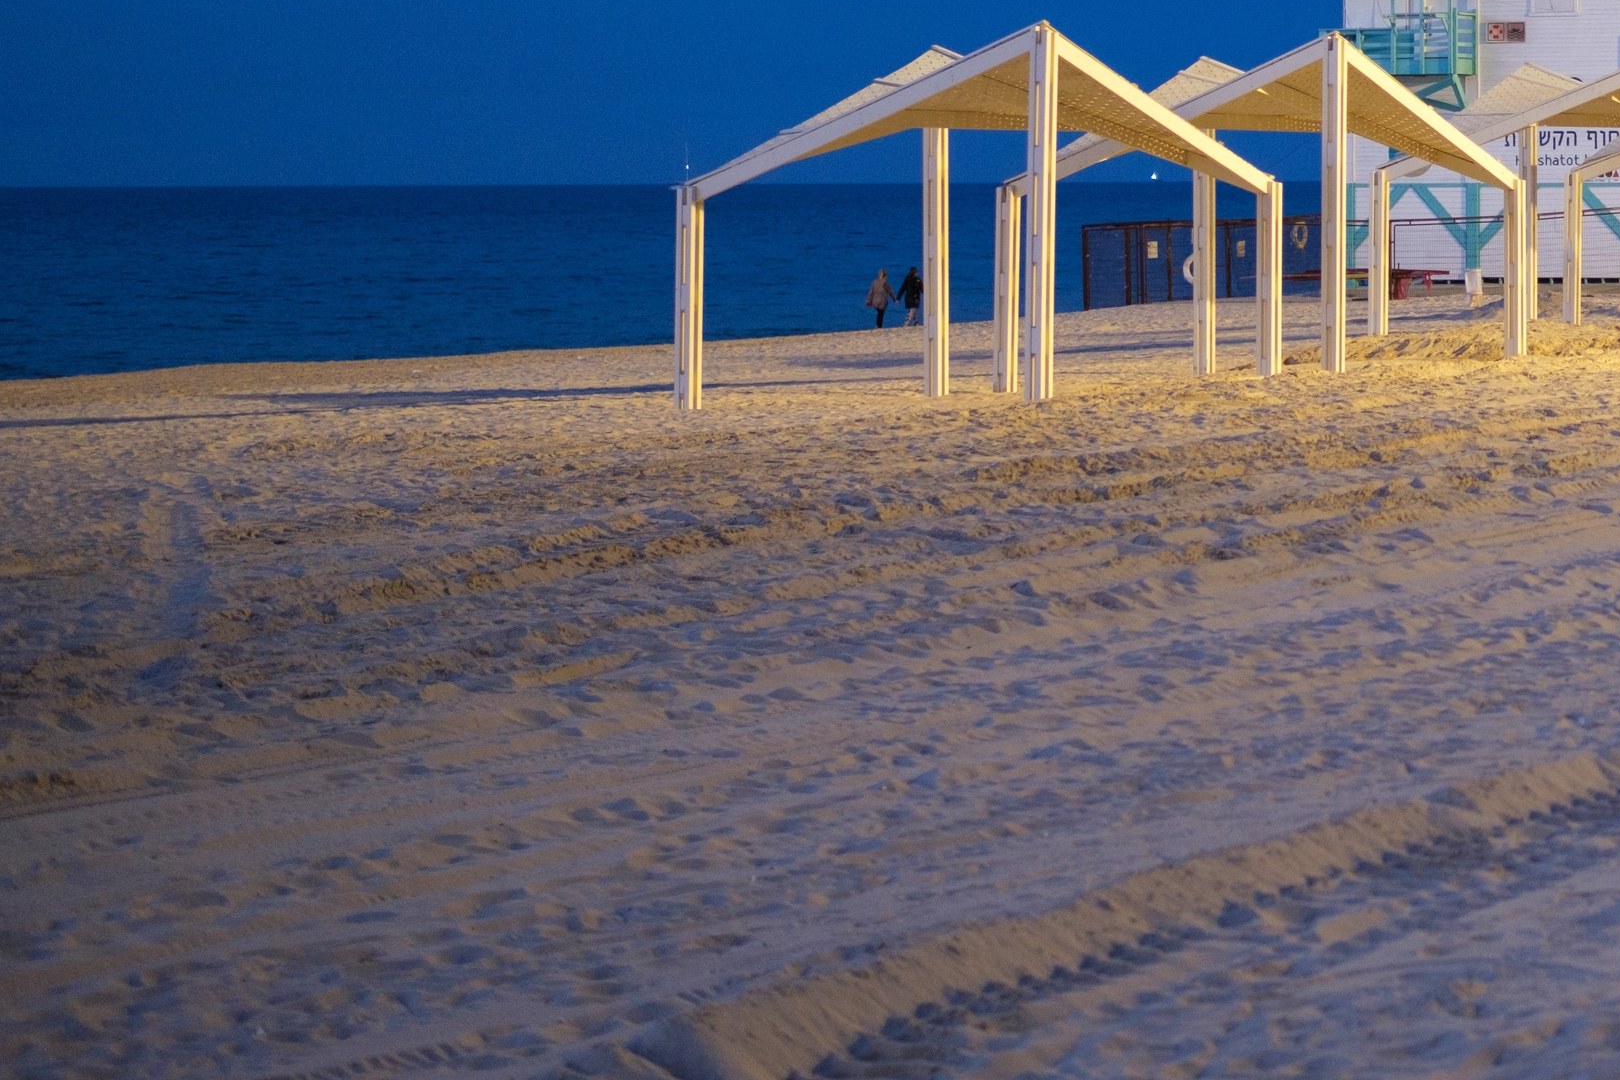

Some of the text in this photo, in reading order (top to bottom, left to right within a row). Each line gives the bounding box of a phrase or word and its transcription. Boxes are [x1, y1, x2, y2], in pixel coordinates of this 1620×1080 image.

[1505, 130, 1620, 150] חוף הקשת
[1515, 154, 1580, 166] Hshatot
